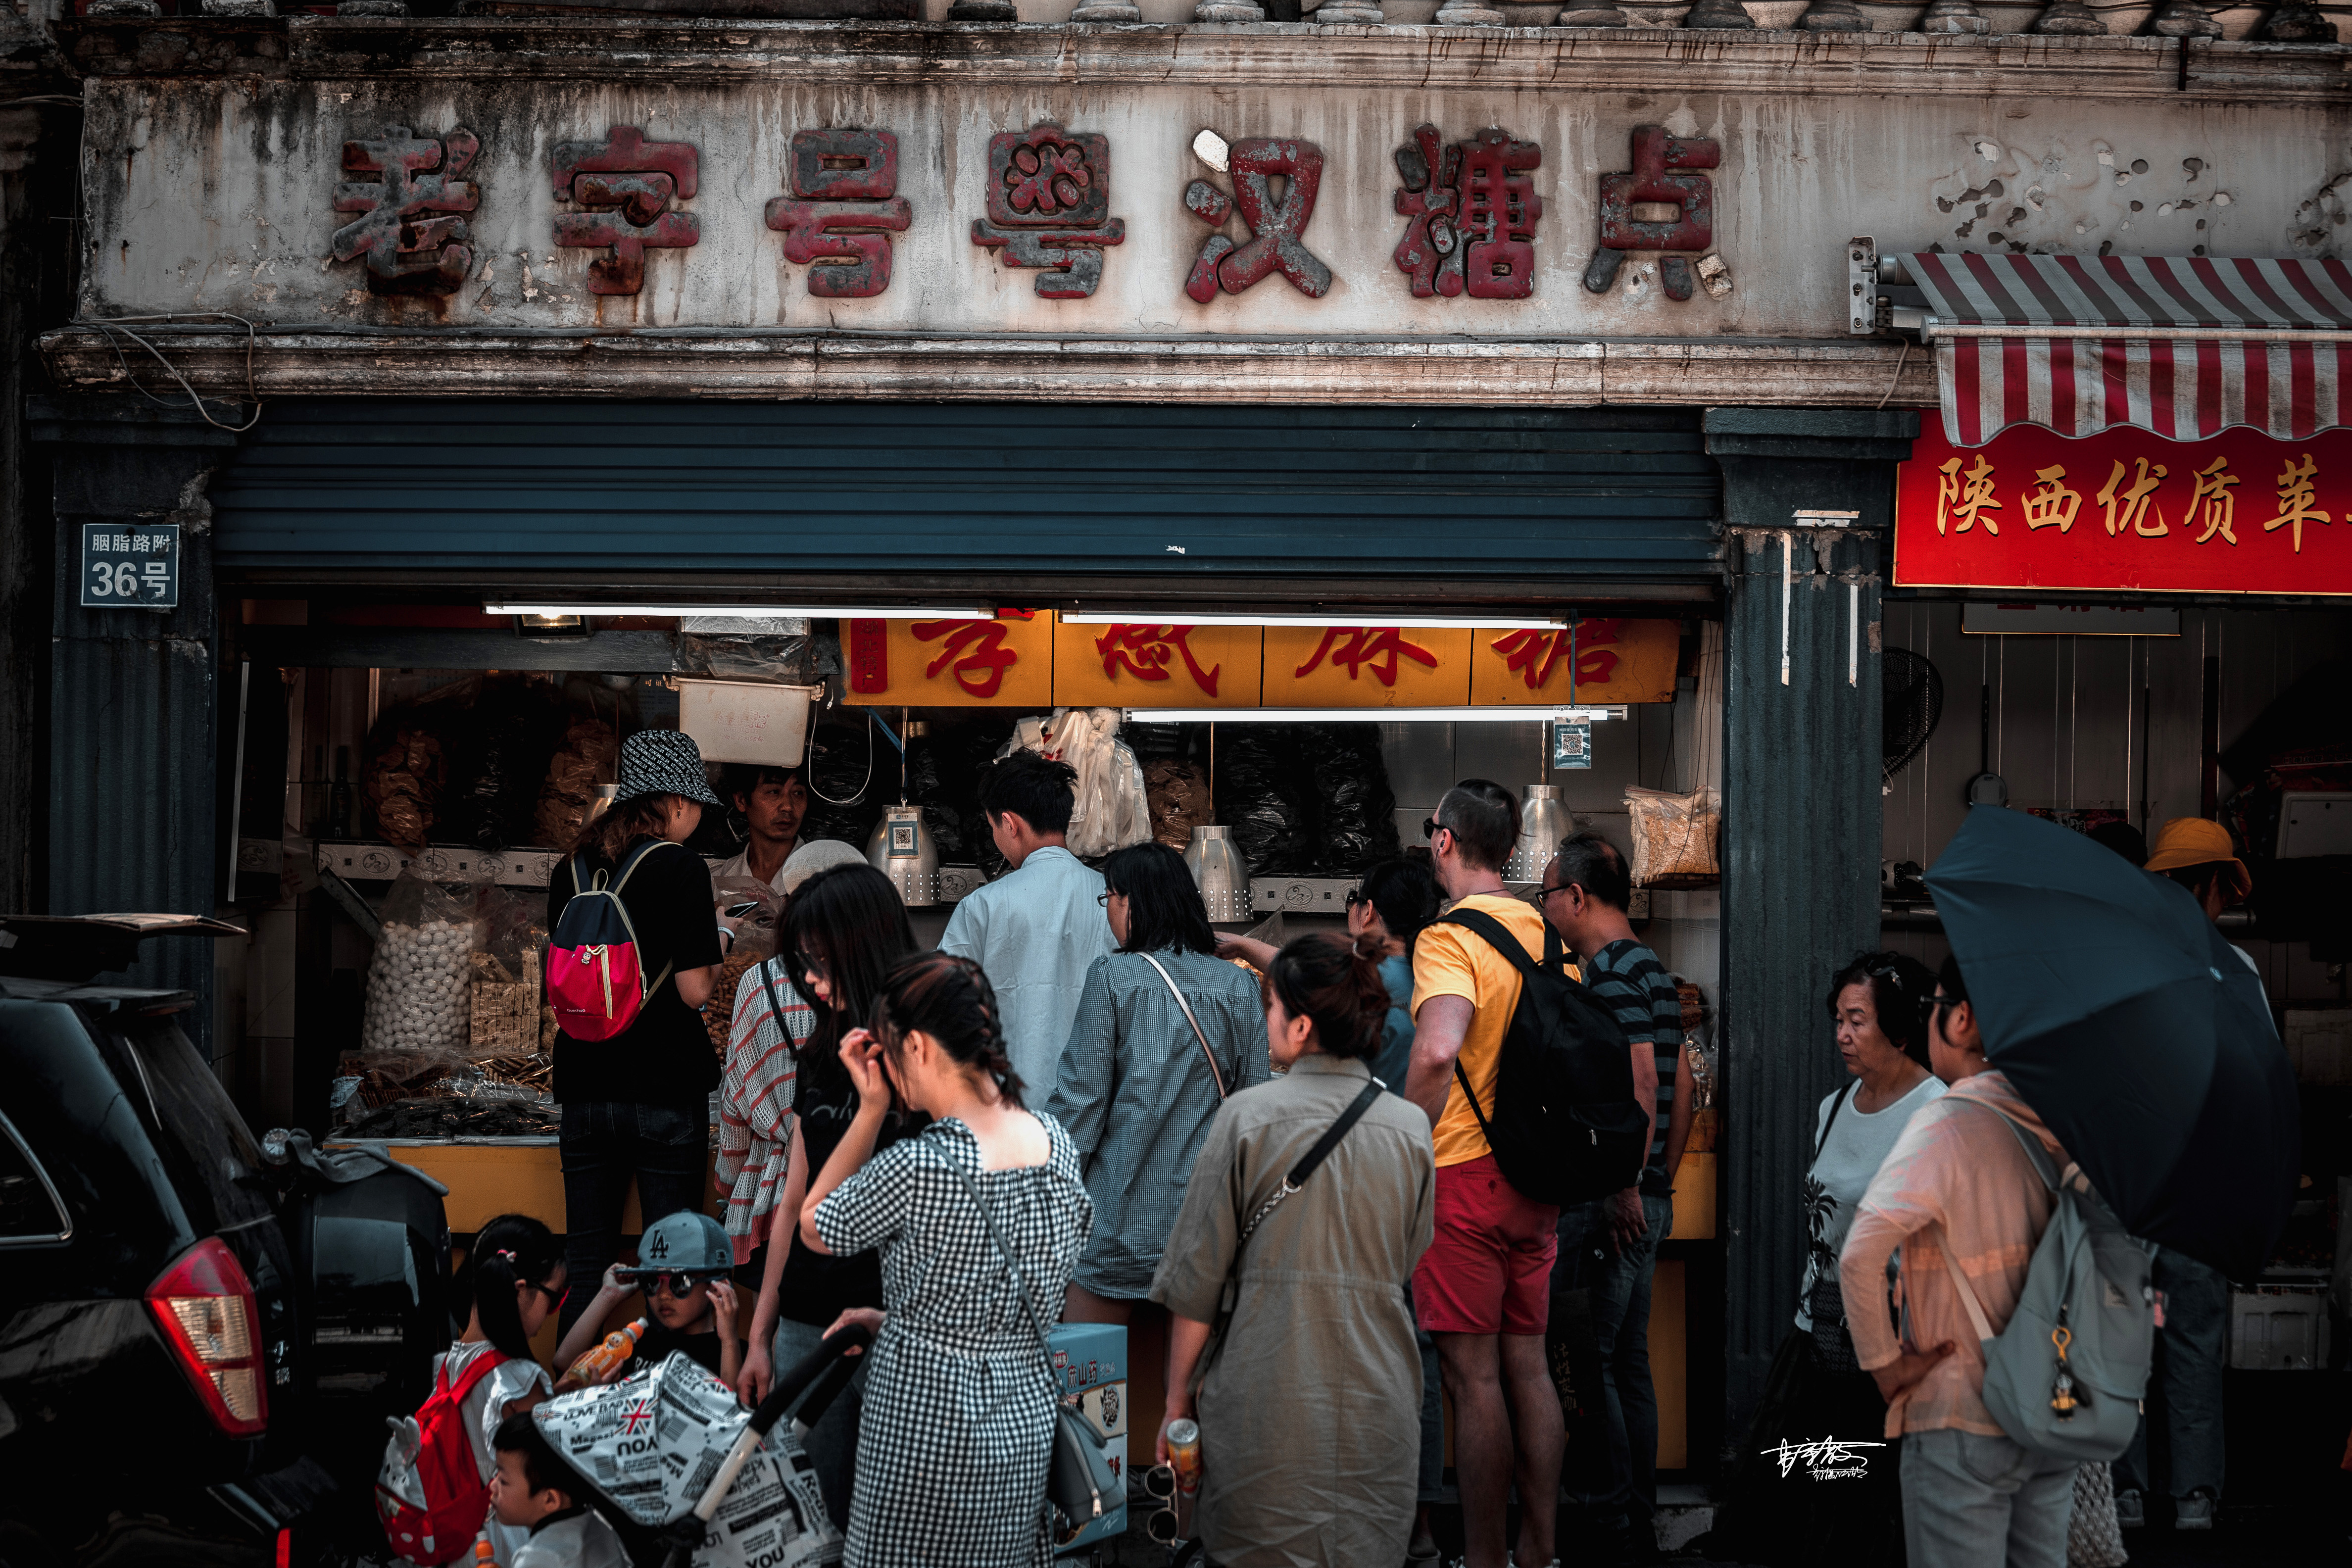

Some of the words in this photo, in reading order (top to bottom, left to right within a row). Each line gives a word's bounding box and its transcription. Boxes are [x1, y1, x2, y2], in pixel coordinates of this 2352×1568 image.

[1936, 453, 2352, 554] 陕西优质苹
[92, 534, 171, 552] 胭脂路附
[91, 562, 170, 597] 36号
[859, 621, 878, 688] 湖北特产
[650, 1229, 669, 1259] LA
[617, 1436, 659, 1457] YOU
